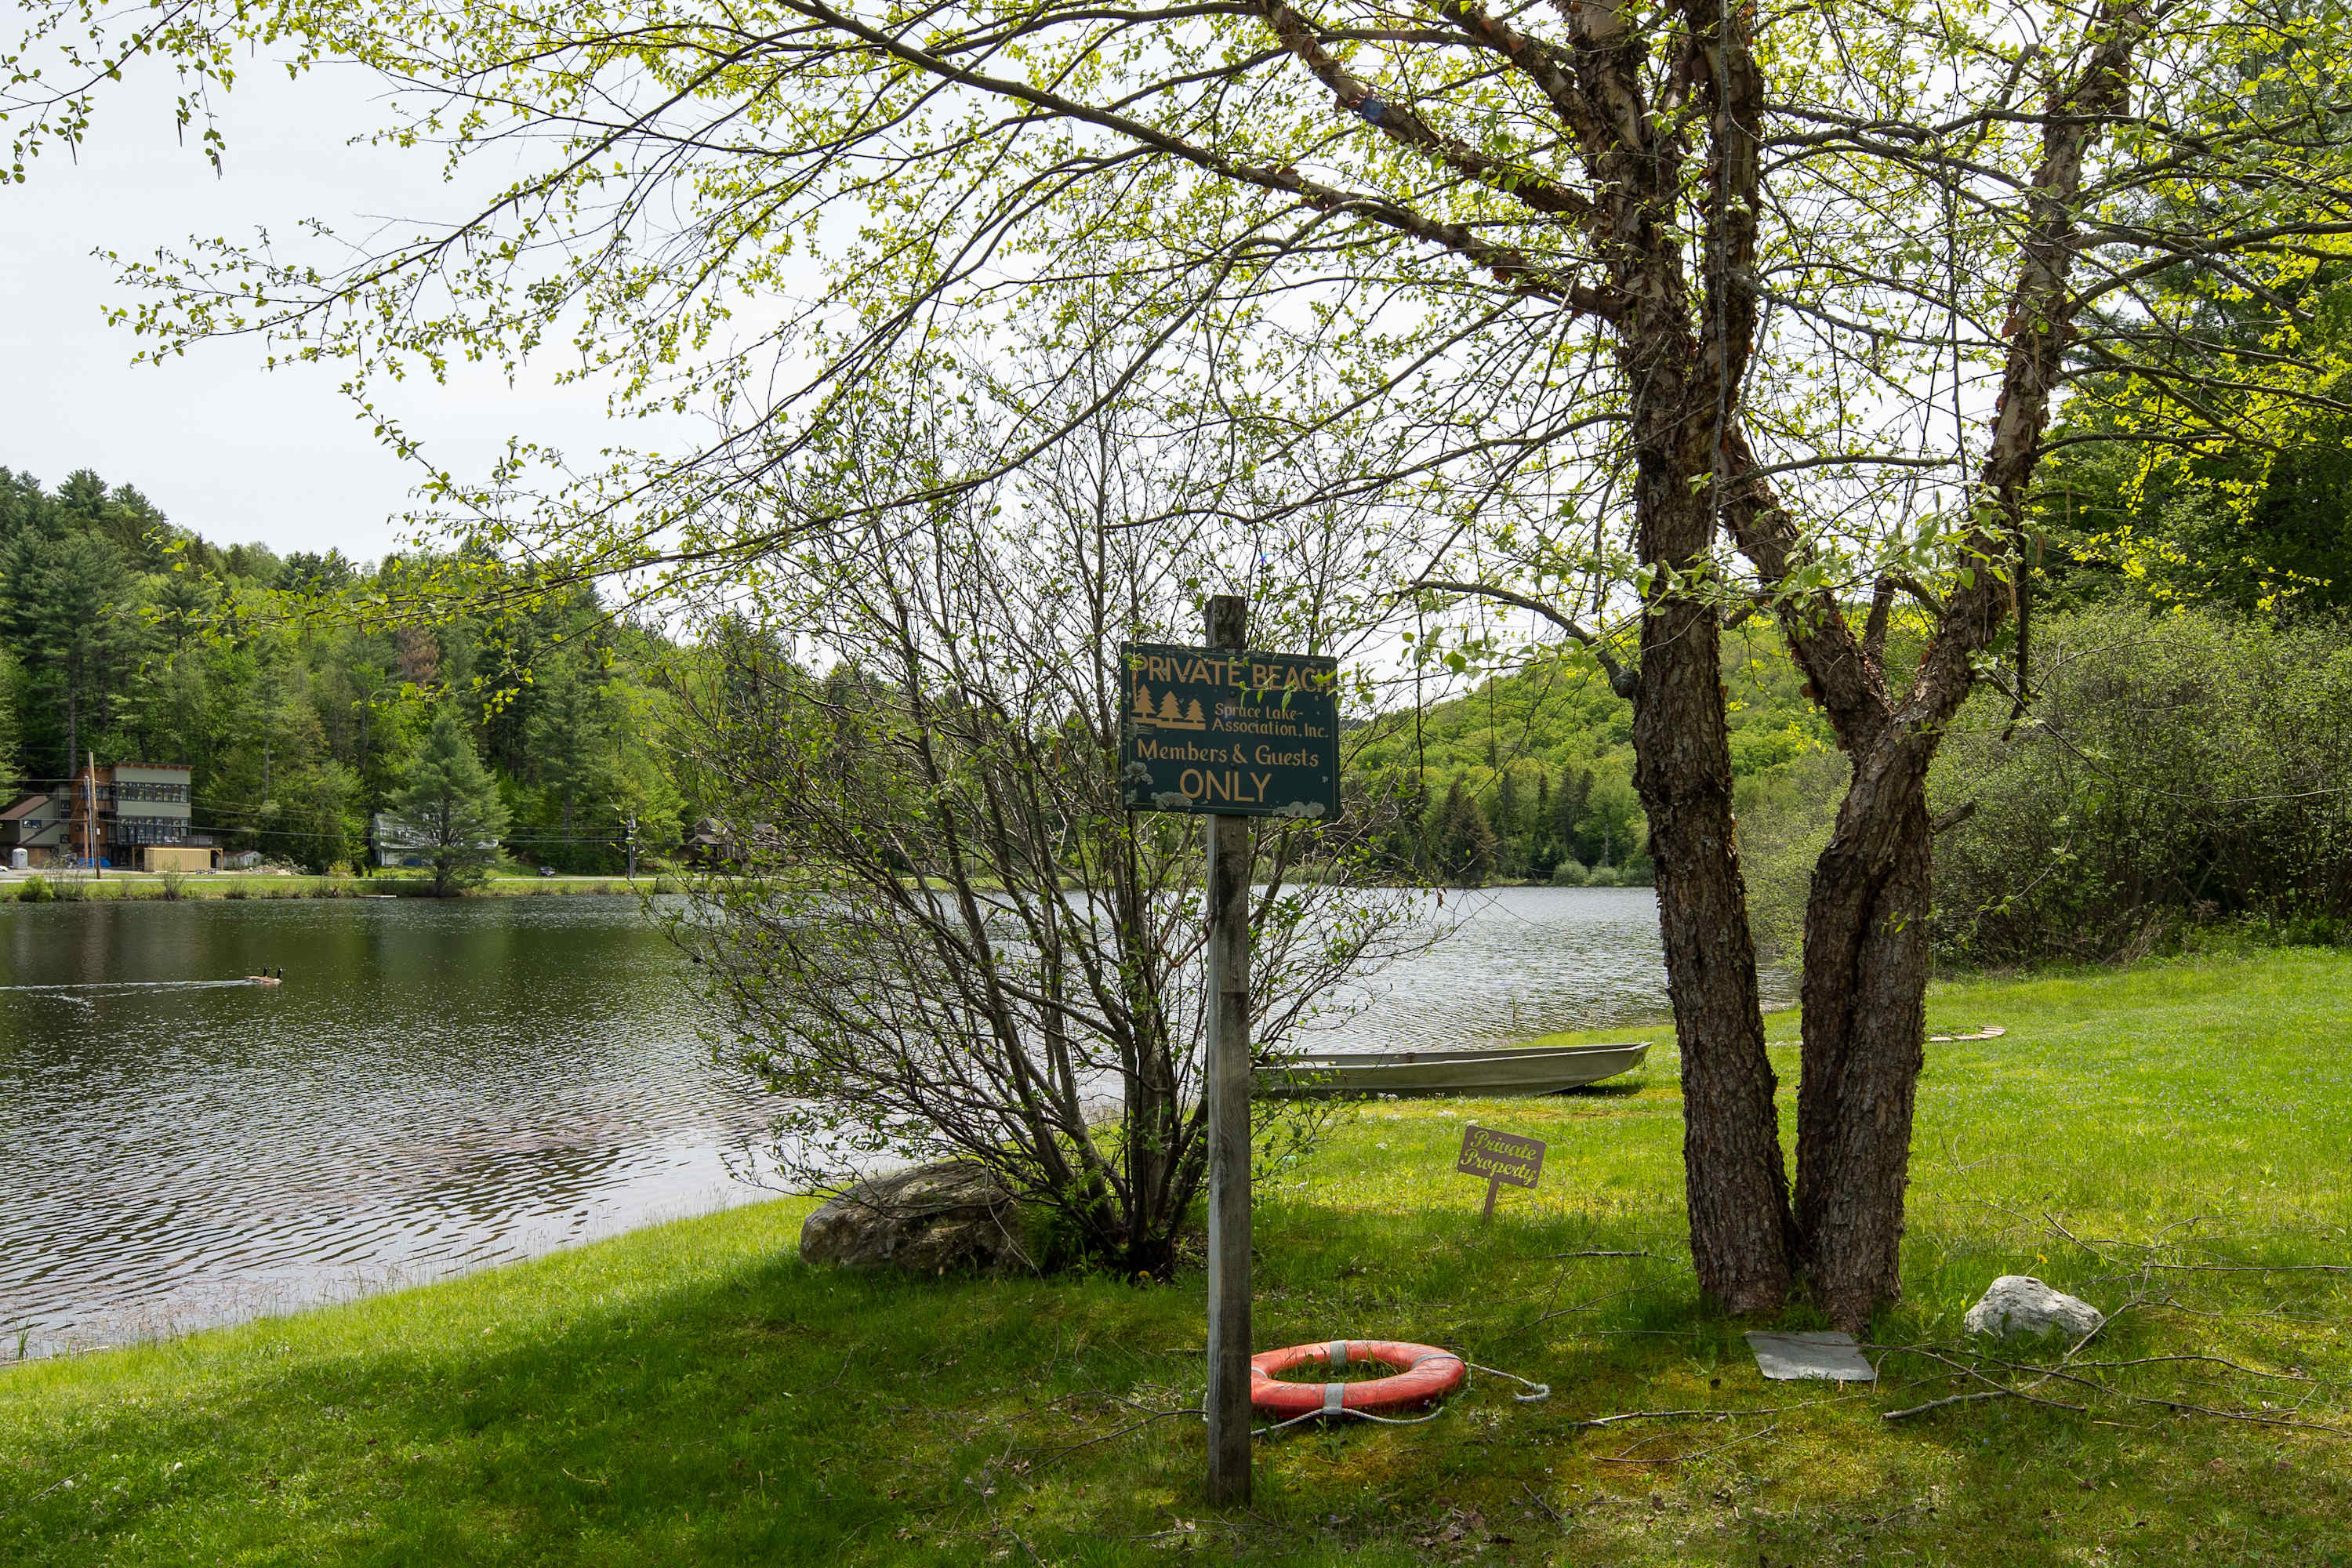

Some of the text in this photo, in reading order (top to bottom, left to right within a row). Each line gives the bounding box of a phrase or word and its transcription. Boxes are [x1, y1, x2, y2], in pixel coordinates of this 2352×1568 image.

[1131, 655, 1331, 693] PRIVATE BEACH
[1214, 702, 1261, 719] Spruce
[1211, 717, 1330, 739] Association, Inc.
[1137, 739, 1319, 768] Members & Guests
[1179, 768, 1272, 804] ONLY
[1470, 1130, 1537, 1160] Private
[1460, 1148, 1537, 1185] Property
